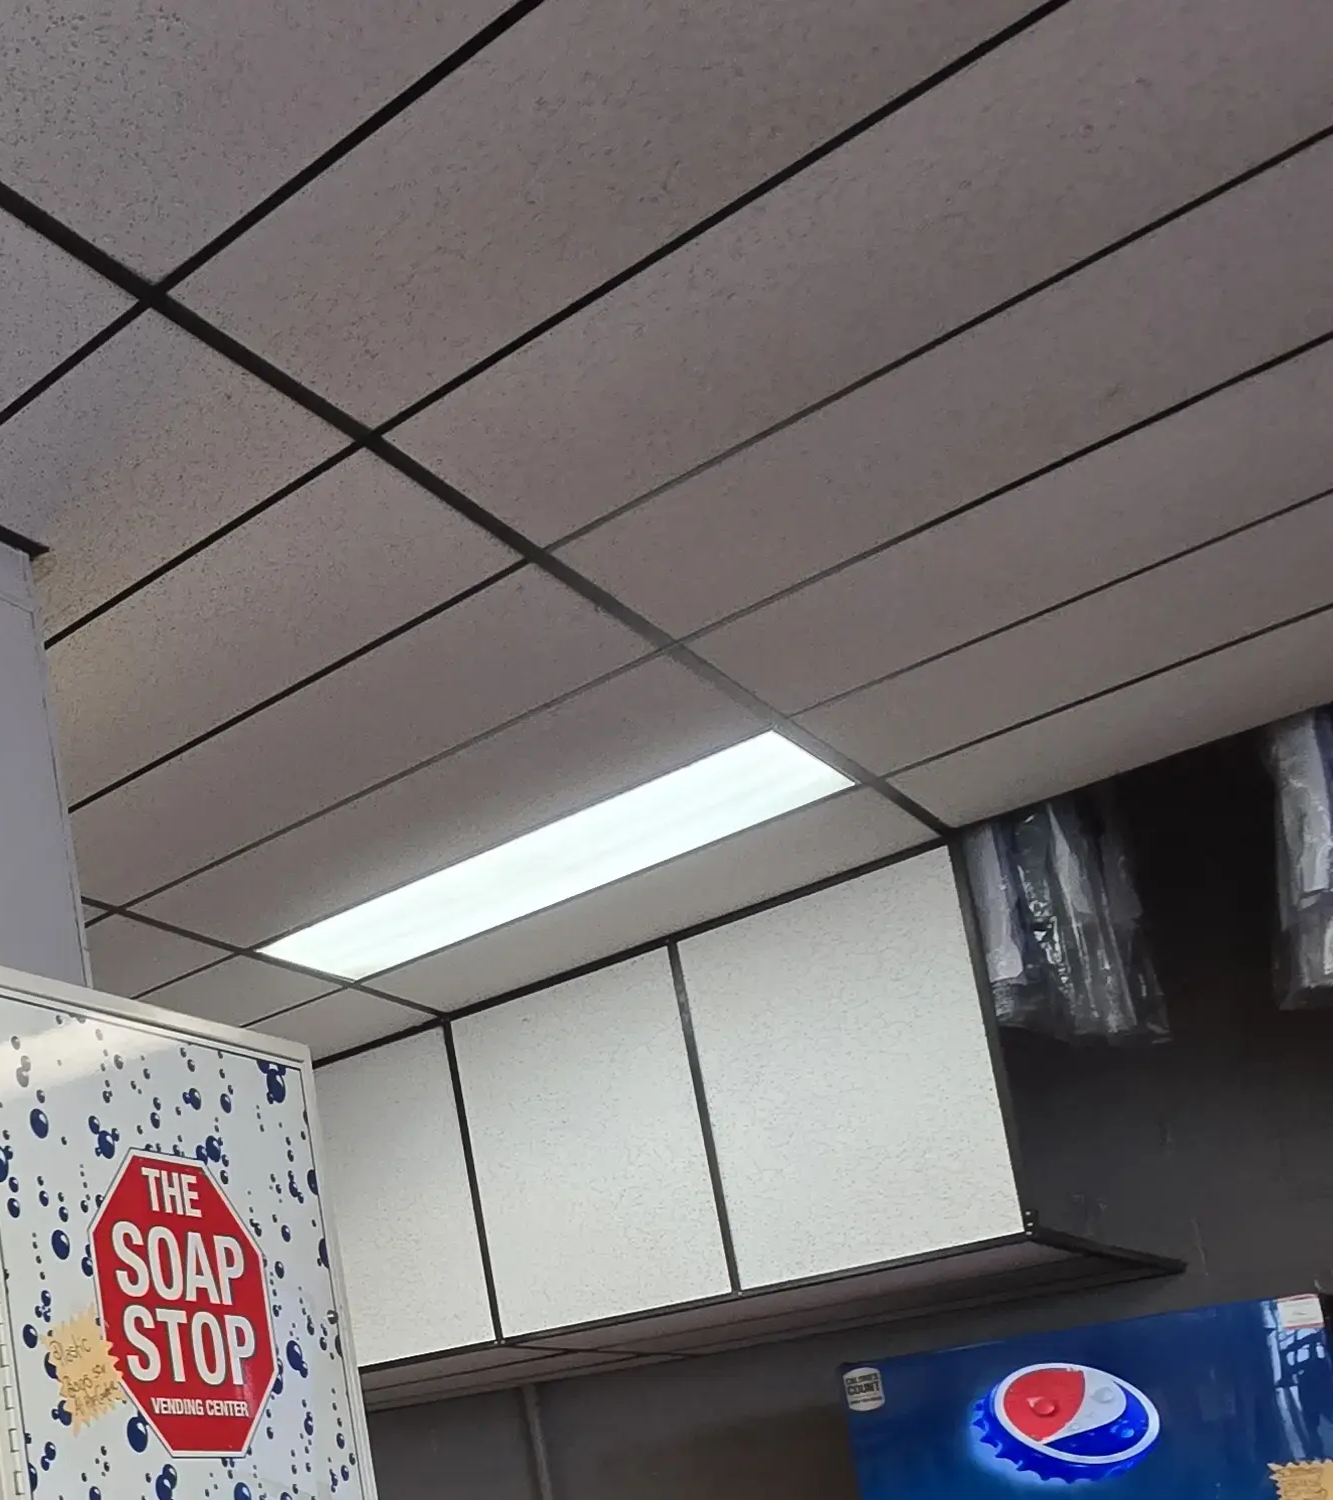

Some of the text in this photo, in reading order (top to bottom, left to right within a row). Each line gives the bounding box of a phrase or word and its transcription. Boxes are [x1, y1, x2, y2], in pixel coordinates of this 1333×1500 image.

[140, 1166, 203, 1219] THE
[111, 1220, 245, 1306] SOAP
[122, 1303, 256, 1386] STOP
[150, 1397, 204, 1417] VENDING
[206, 1399, 250, 1418] CENTER
